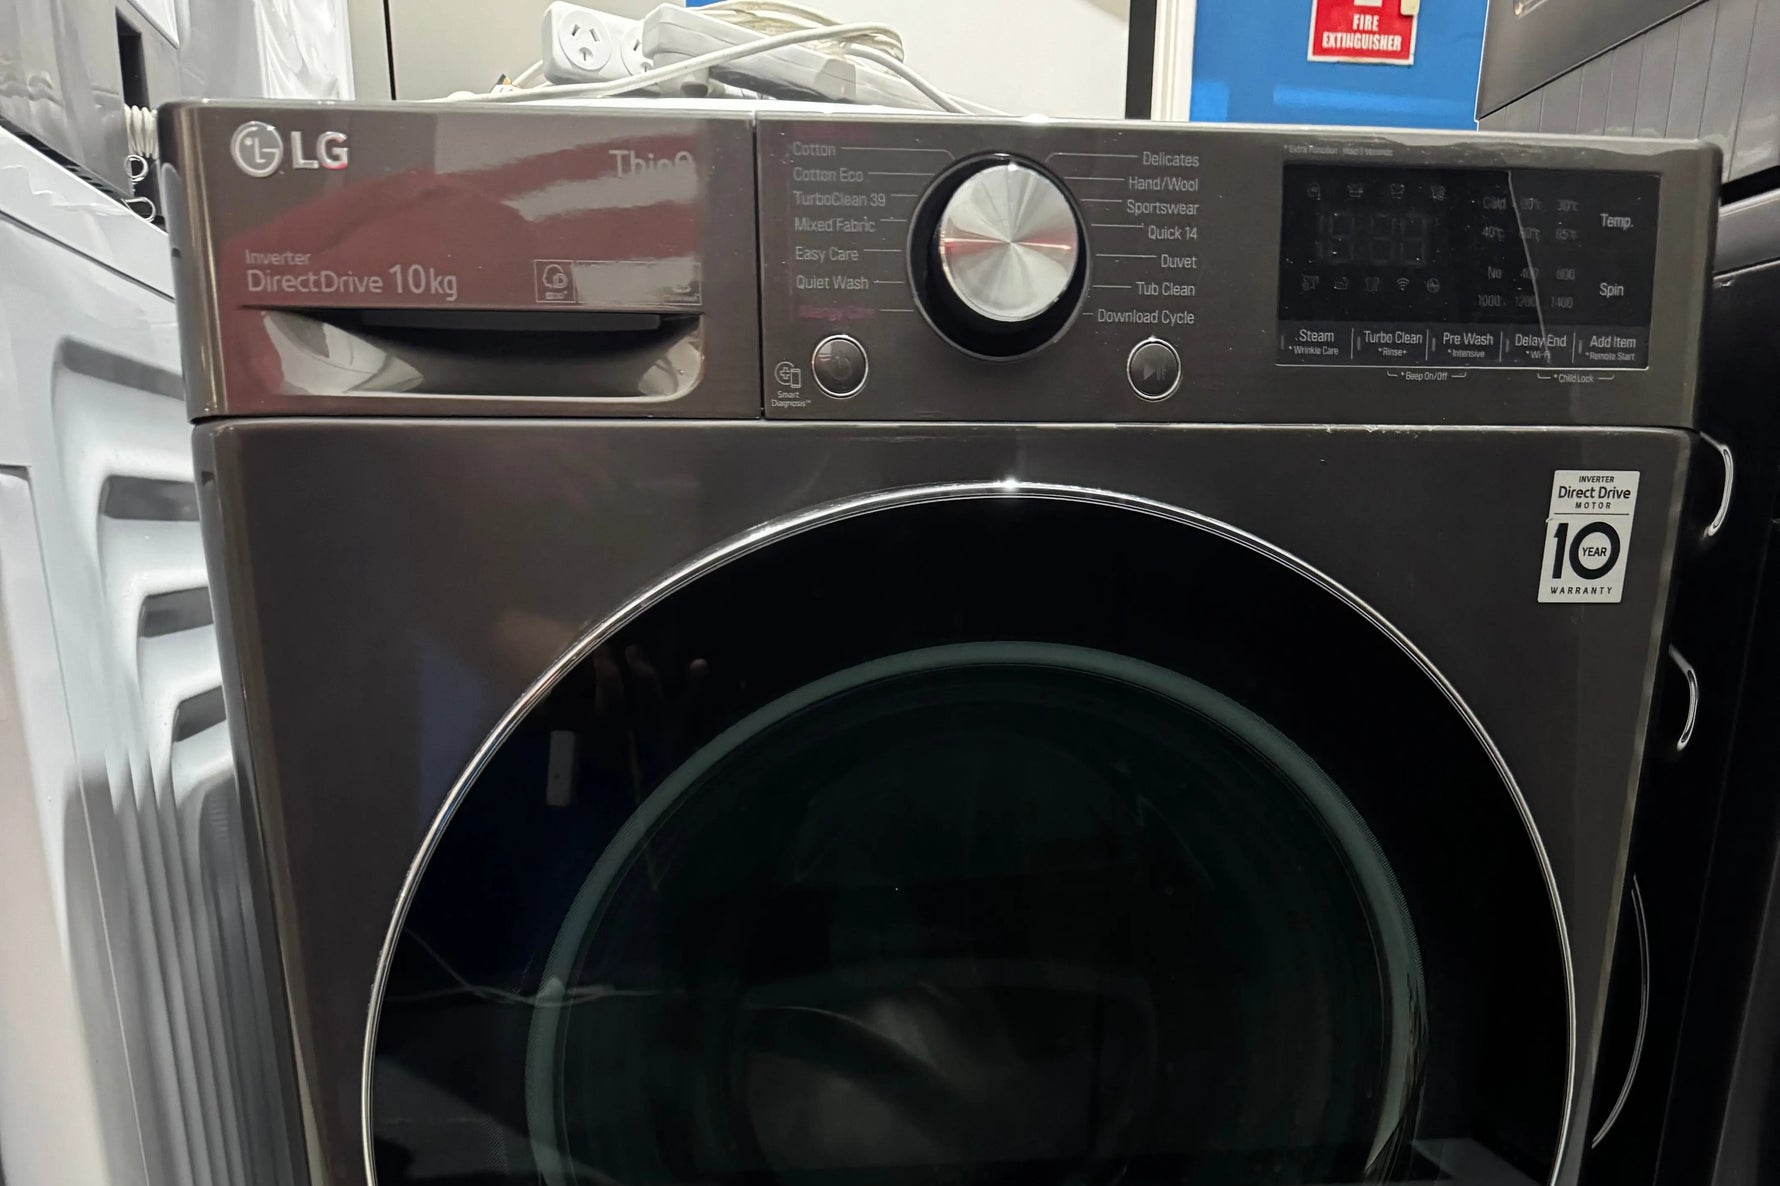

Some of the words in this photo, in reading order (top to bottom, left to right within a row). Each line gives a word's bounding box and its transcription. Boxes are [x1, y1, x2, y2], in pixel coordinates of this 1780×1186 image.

[1352, 14, 1380, 32] FIRE
[1322, 32, 1402, 51] EXTINGUISHER
[291, 131, 349, 170] LG
[793, 141, 836, 156] Cotton
[1143, 151, 1199, 167] Delicates
[793, 167, 837, 181] Cotton
[839, 168, 864, 182] Eco
[1128, 176, 1199, 191] Hand/Wool
[793, 191, 867, 206] TurboClean
[870, 193, 886, 207] 39
[1127, 199, 1199, 216] Sportswear
[794, 217, 833, 231] Mixed
[836, 218, 876, 232] Fabric
[1600, 213, 1634, 230] Temp.
[1148, 225, 1182, 240] Quick
[1185, 227, 1198, 240] 14
[245, 250, 311, 265] Inverter
[795, 246, 826, 263] Easy
[829, 247, 859, 261] Care
[1161, 254, 1197, 269] Duvet
[247, 269, 383, 293] DirectDrive
[796, 275, 829, 289] Quiet
[833, 276, 869, 290] Wash
[1136, 281, 1158, 295] Tub
[1161, 282, 1195, 296] Clean
[1599, 282, 1624, 299] Spin
[1098, 309, 1158, 323] Download
[1161, 310, 1195, 326] Cycle
[1299, 329, 1335, 342] Steam
[1364, 330, 1393, 344] Turbo
[1395, 331, 1423, 344] Clean
[1443, 332, 1461, 345] Pre
[1463, 333, 1493, 346] Wash
[1515, 334, 1545, 348] Delay
[1547, 335, 1567, 347] End
[1590, 336, 1612, 348] Add
[1613, 336, 1636, 348] Item
[1322, 346, 1339, 355] Care
[1617, 352, 1635, 361] Start
[1405, 372, 1423, 381] Beep
[1424, 372, 1448, 381] On/Off
[1578, 374, 1594, 383] Lock
[777, 391, 799, 399] Smart
[1558, 486, 1595, 499] Direct
[1598, 487, 1631, 499] Drive
[1552, 521, 1621, 580] 10
[1582, 547, 1607, 557] YEAR
